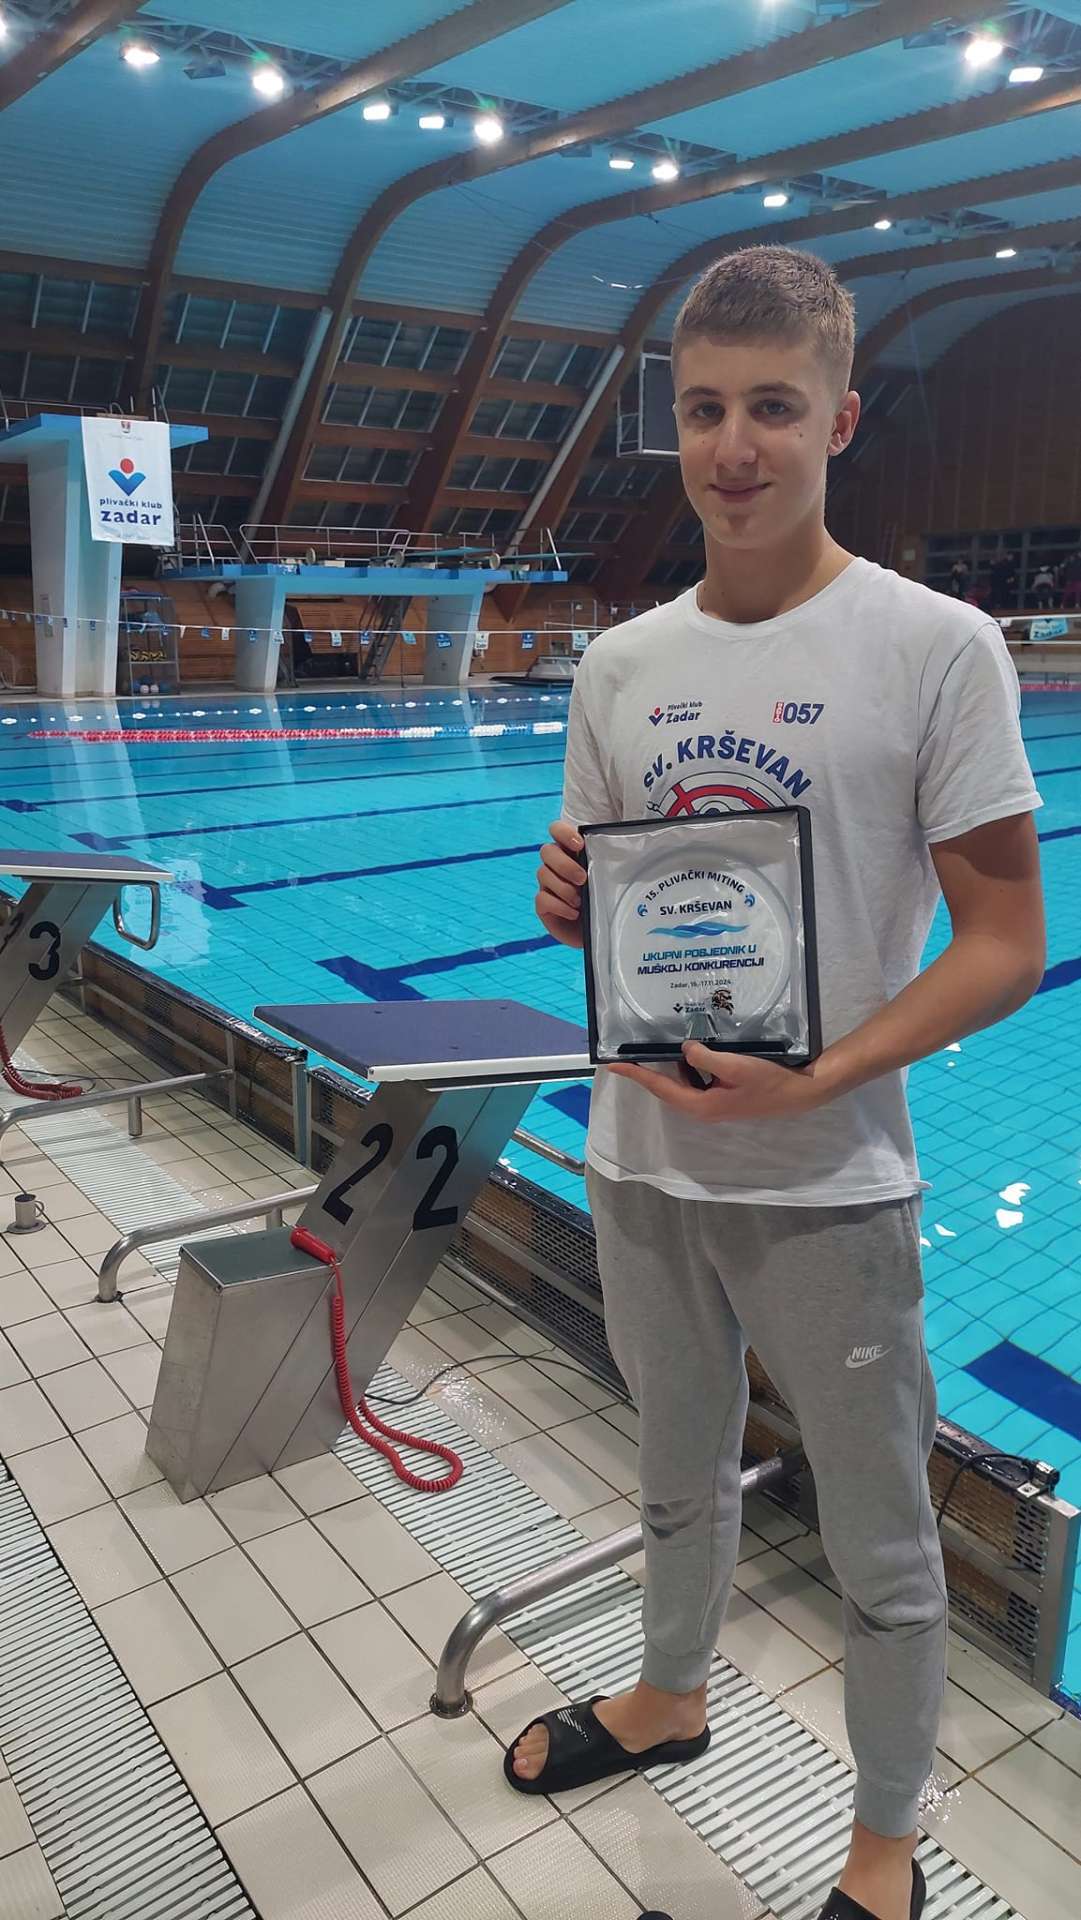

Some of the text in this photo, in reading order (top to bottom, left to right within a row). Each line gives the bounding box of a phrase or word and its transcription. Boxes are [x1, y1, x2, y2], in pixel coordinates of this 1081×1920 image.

[99, 497, 162, 509] plivački klub
[100, 510, 161, 525] zadar
[666, 710, 701, 723] Zadar
[783, 702, 825, 725] 057
[643, 730, 812, 799] SV. KRŠEVAN
[645, 869, 746, 902] 15. PLIVAČKI MITING
[660, 900, 732, 916] SV. KRŠEVAN
[28, 921, 61, 981] 3
[643, 944, 757, 961] UKUPNI POBJEDNIK U
[637, 957, 765, 975] MUŠKOJ KONKURENCIJI
[322, 1122, 394, 1226] 2
[412, 1125, 460, 1231] 2
[851, 1344, 882, 1359] NIKE
